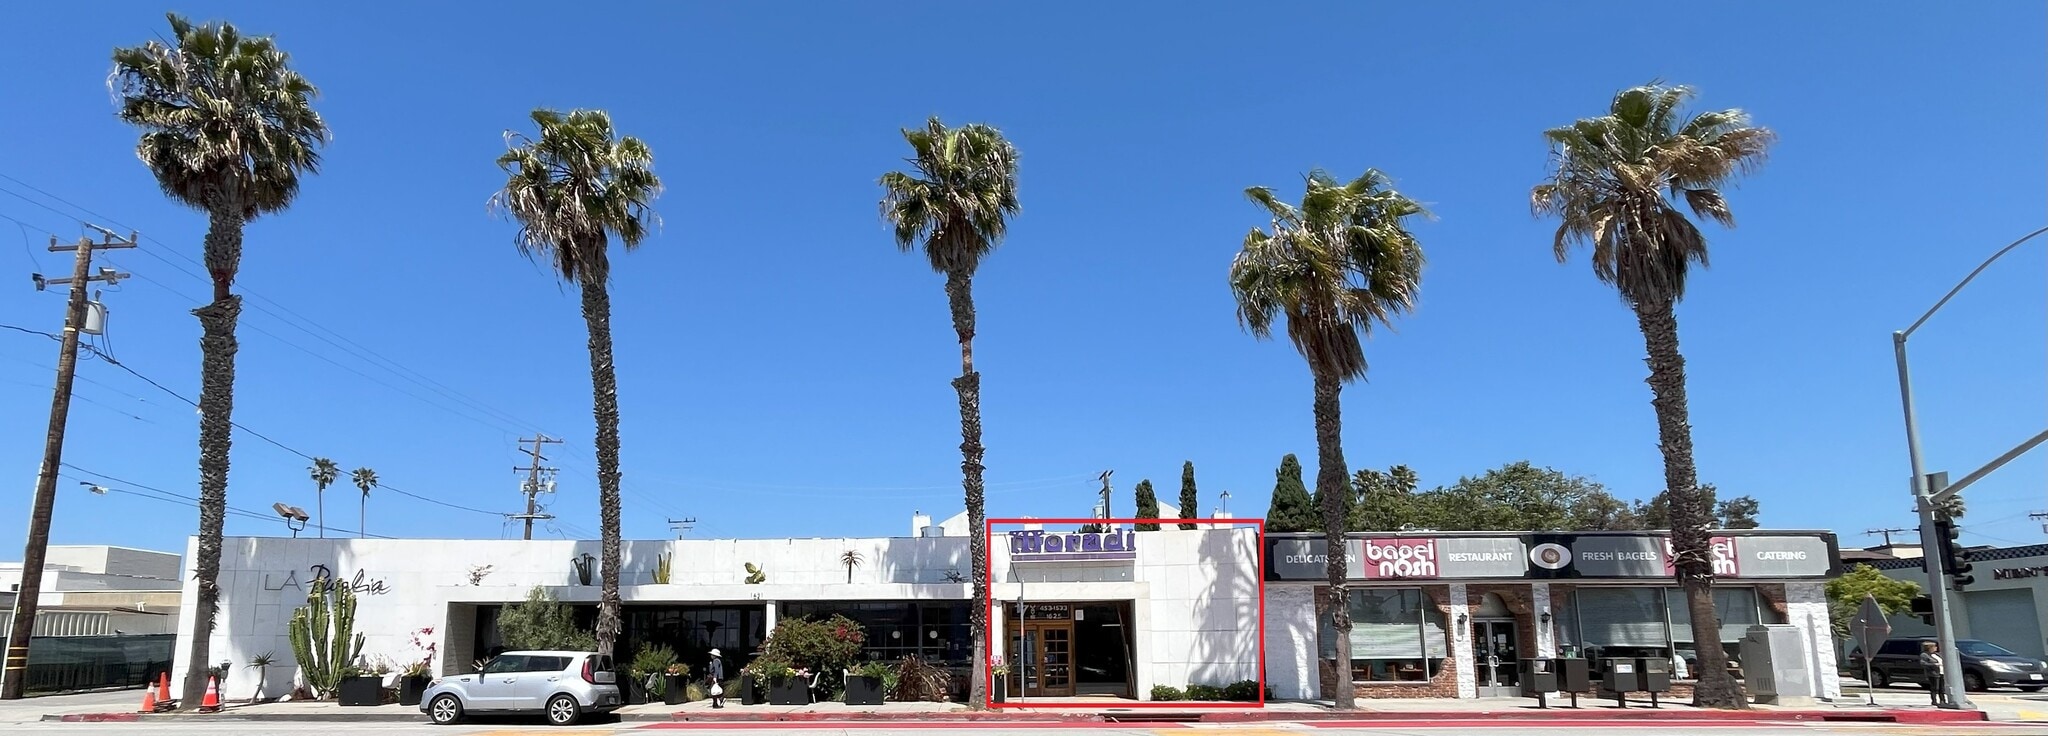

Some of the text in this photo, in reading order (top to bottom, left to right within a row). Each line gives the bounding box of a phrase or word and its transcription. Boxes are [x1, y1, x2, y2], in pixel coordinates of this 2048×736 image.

[1009, 528, 1136, 554] Moradi
[1366, 539, 1435, 560] bagel
[1664, 538, 1735, 559] bel
[1285, 553, 1356, 564] DELICATEEN
[1448, 552, 1513, 562] RESTAURANT
[1582, 552, 1657, 561] FRESH BAGELS
[1757, 551, 1807, 560] CATERING
[1379, 558, 1436, 577] nosh
[264, 570, 302, 592] LA
